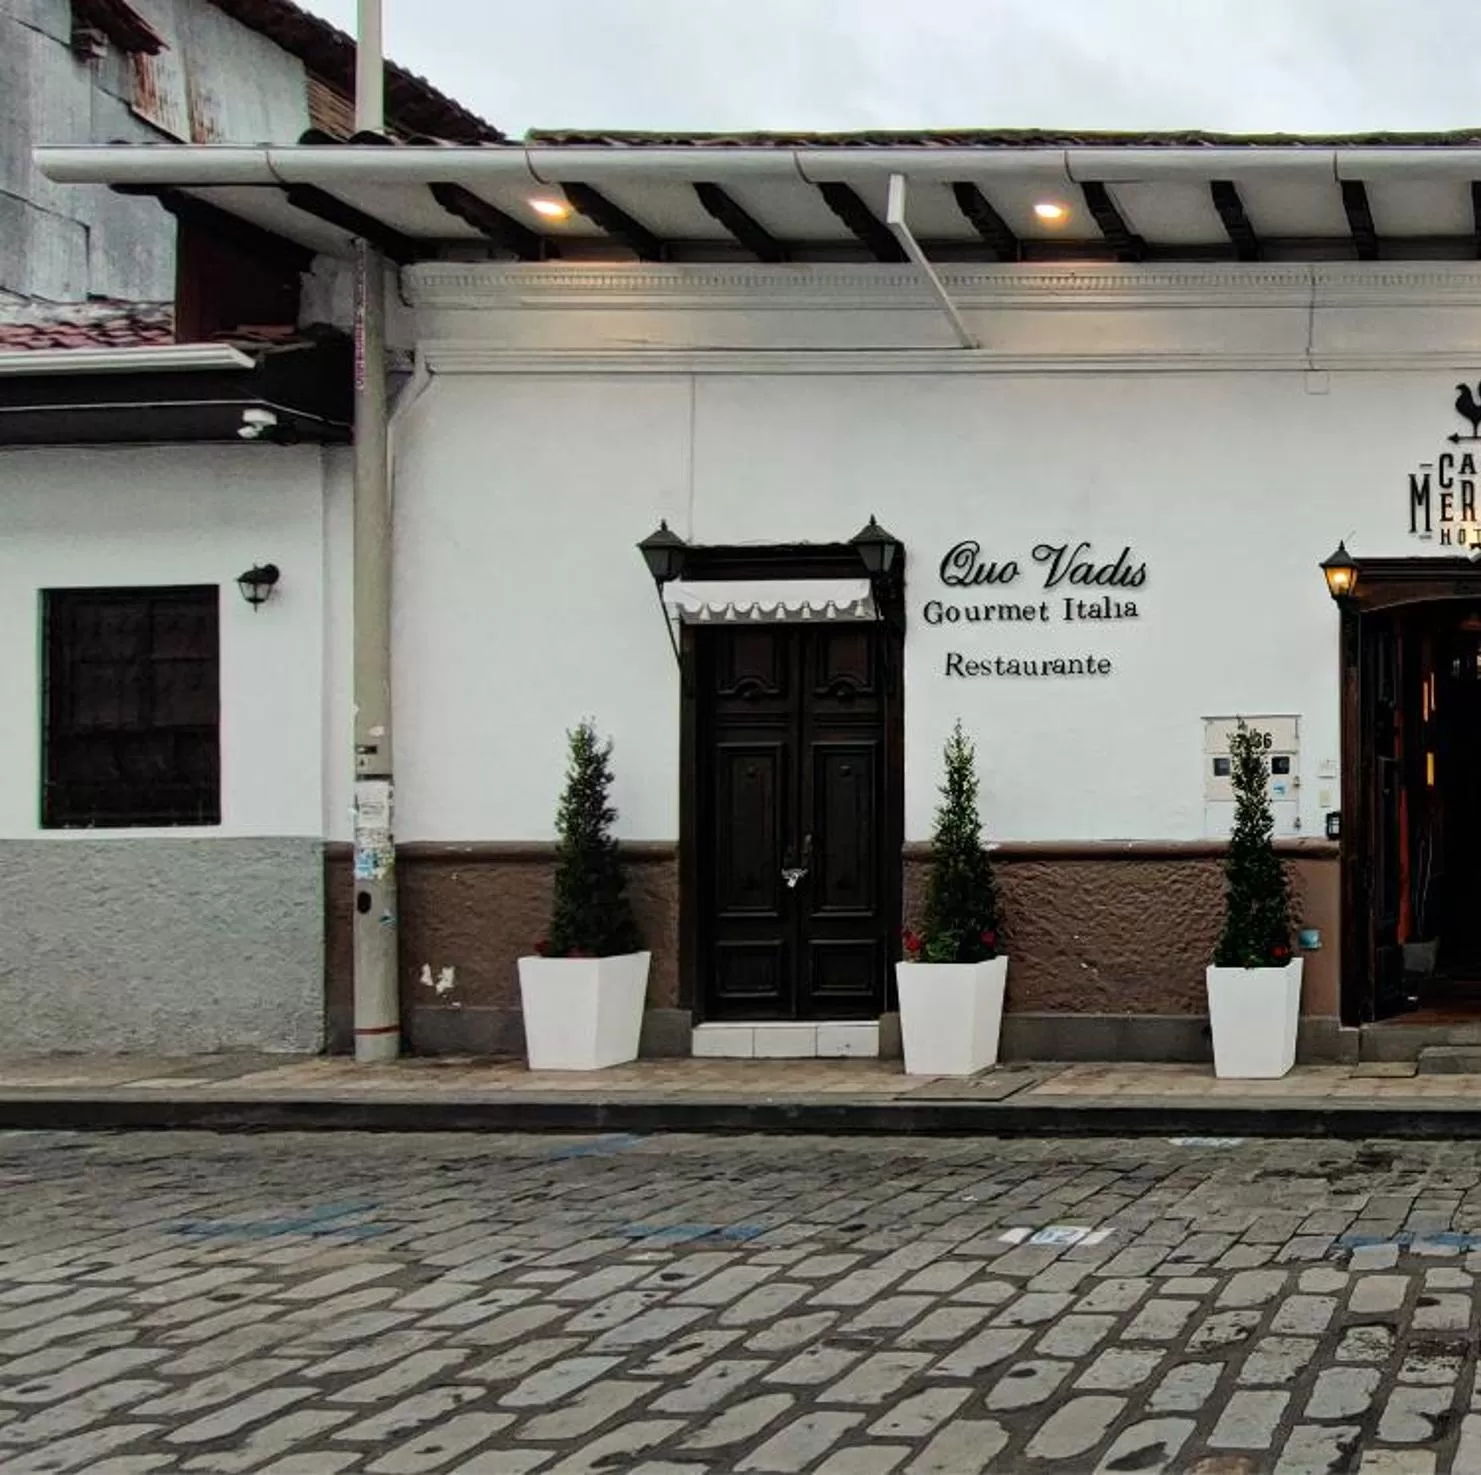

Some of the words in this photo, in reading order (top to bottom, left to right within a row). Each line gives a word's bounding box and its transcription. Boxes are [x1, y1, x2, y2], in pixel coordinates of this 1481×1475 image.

[939, 540, 1020, 588] Quo
[1031, 542, 1147, 588] Vadis
[923, 600, 1050, 625] Gourmet
[1062, 596, 1139, 621] Italia
[944, 652, 1112, 678] Restaurante
